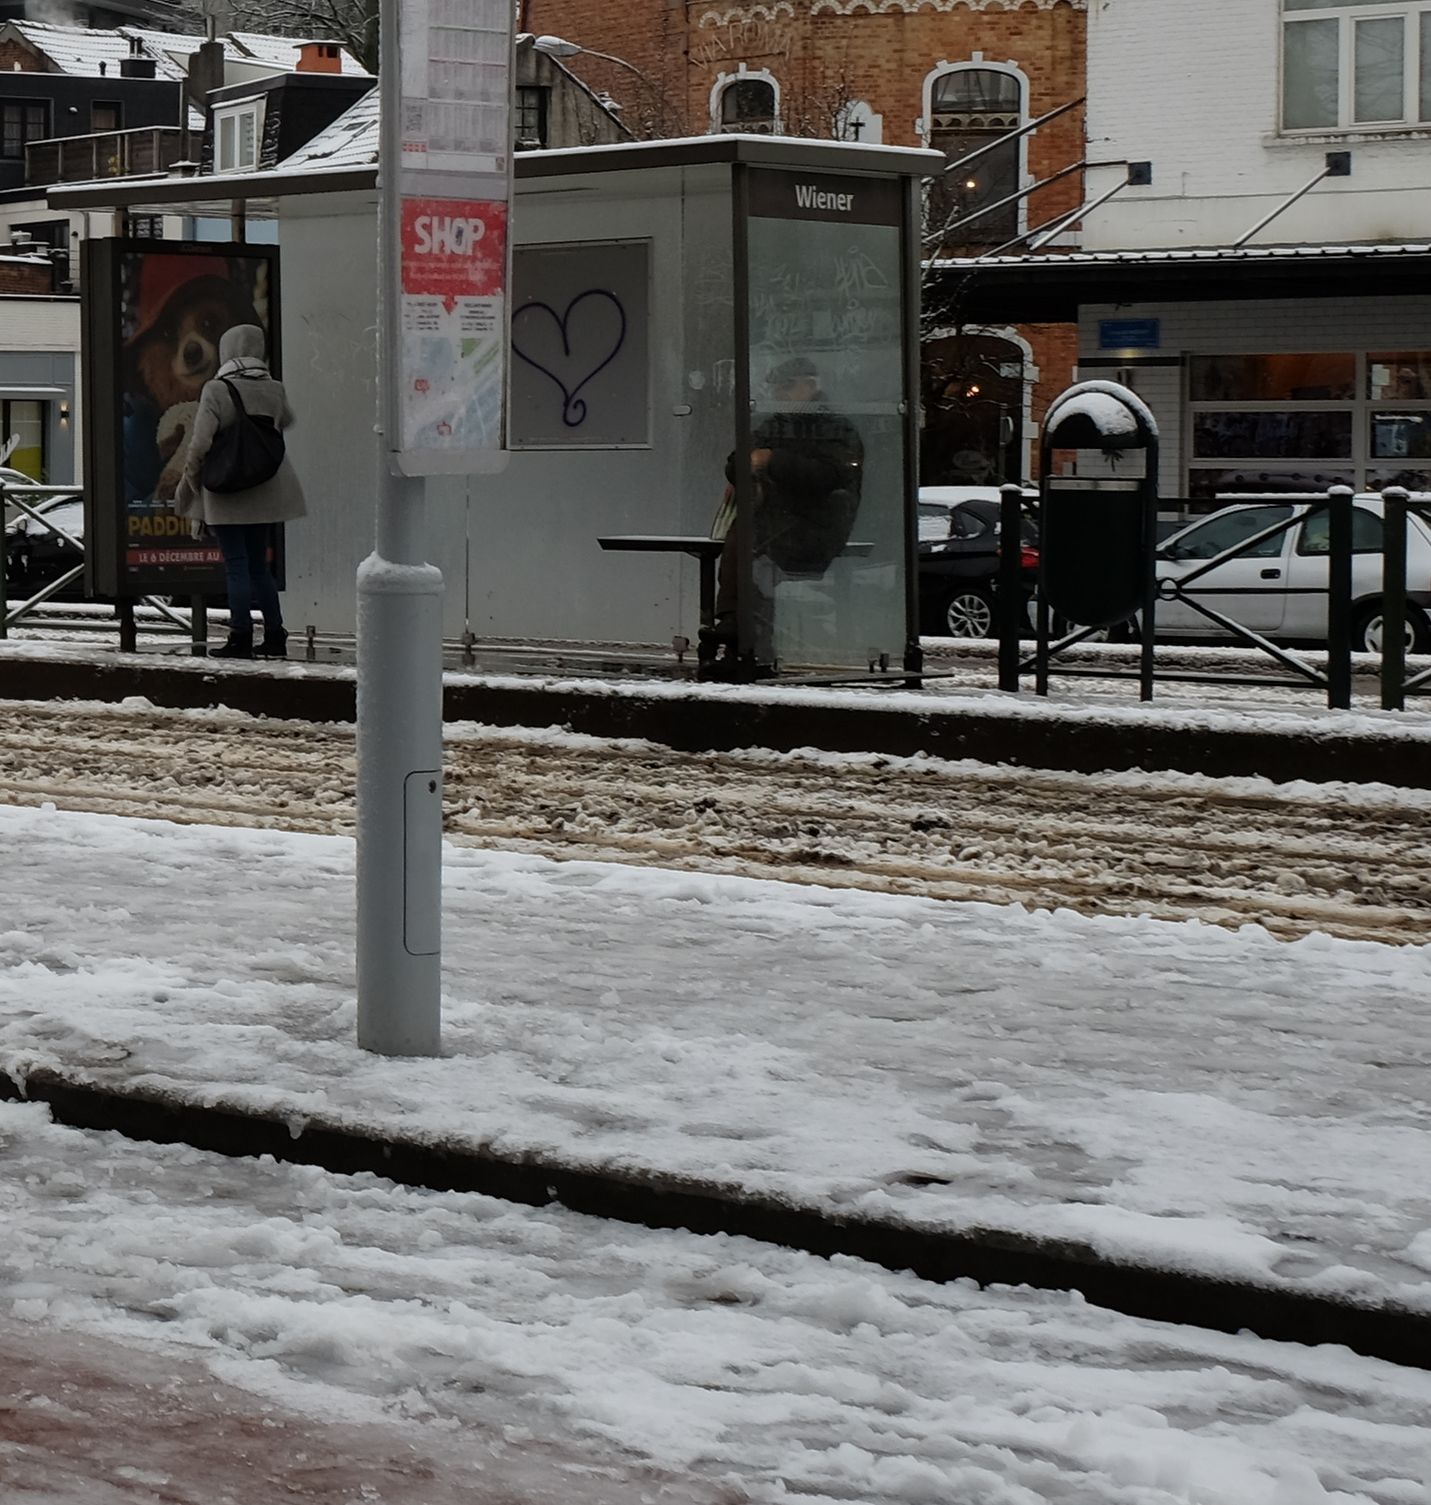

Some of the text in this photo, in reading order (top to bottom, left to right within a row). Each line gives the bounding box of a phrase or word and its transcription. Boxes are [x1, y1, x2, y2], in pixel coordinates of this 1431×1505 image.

[795, 185, 855, 212] Wiener
[414, 215, 486, 256] SHOP
[139, 551, 220, 563] LE 6 DÉCEMBRE AU
